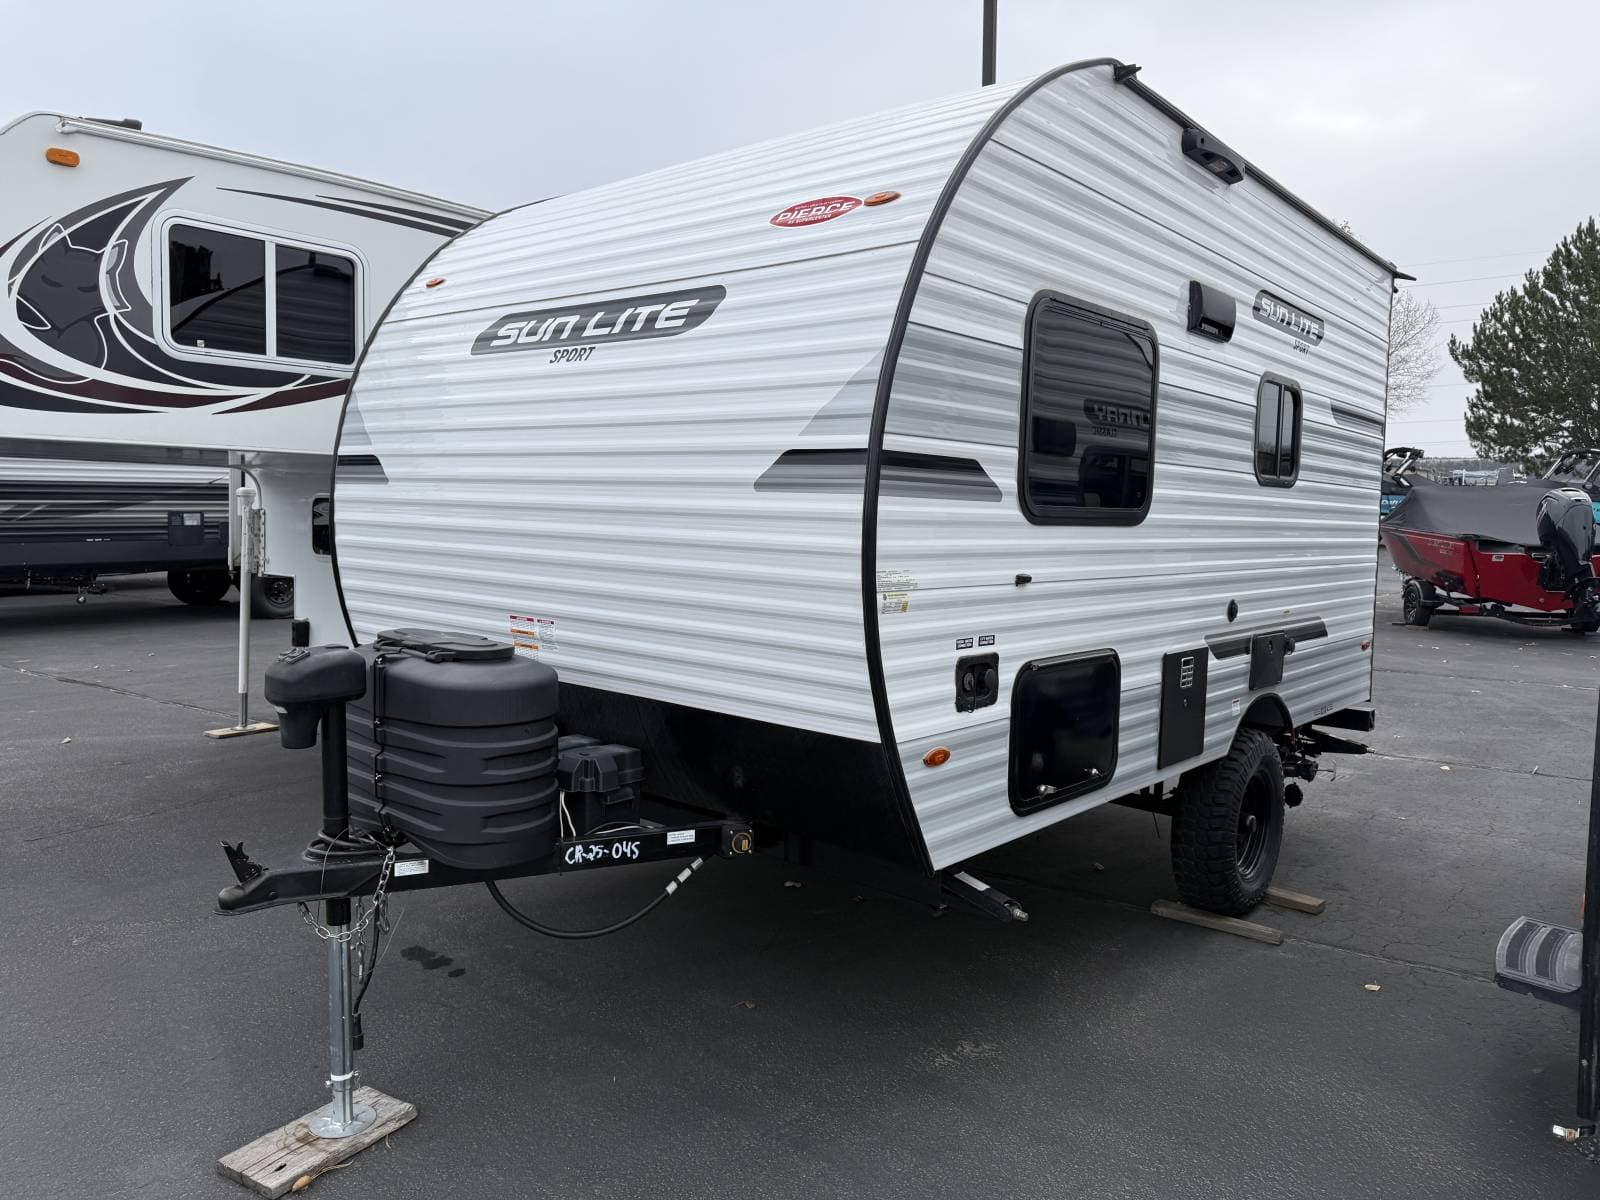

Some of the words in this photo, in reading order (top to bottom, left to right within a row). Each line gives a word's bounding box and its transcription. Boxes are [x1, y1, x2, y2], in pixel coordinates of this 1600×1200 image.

[778, 201, 856, 221] PIERCE
[490, 314, 581, 347] SUN
[581, 298, 700, 337] LITE
[1259, 297, 1289, 326] SUN
[1289, 312, 1320, 340] LITE
[549, 346, 597, 364] SPORT
